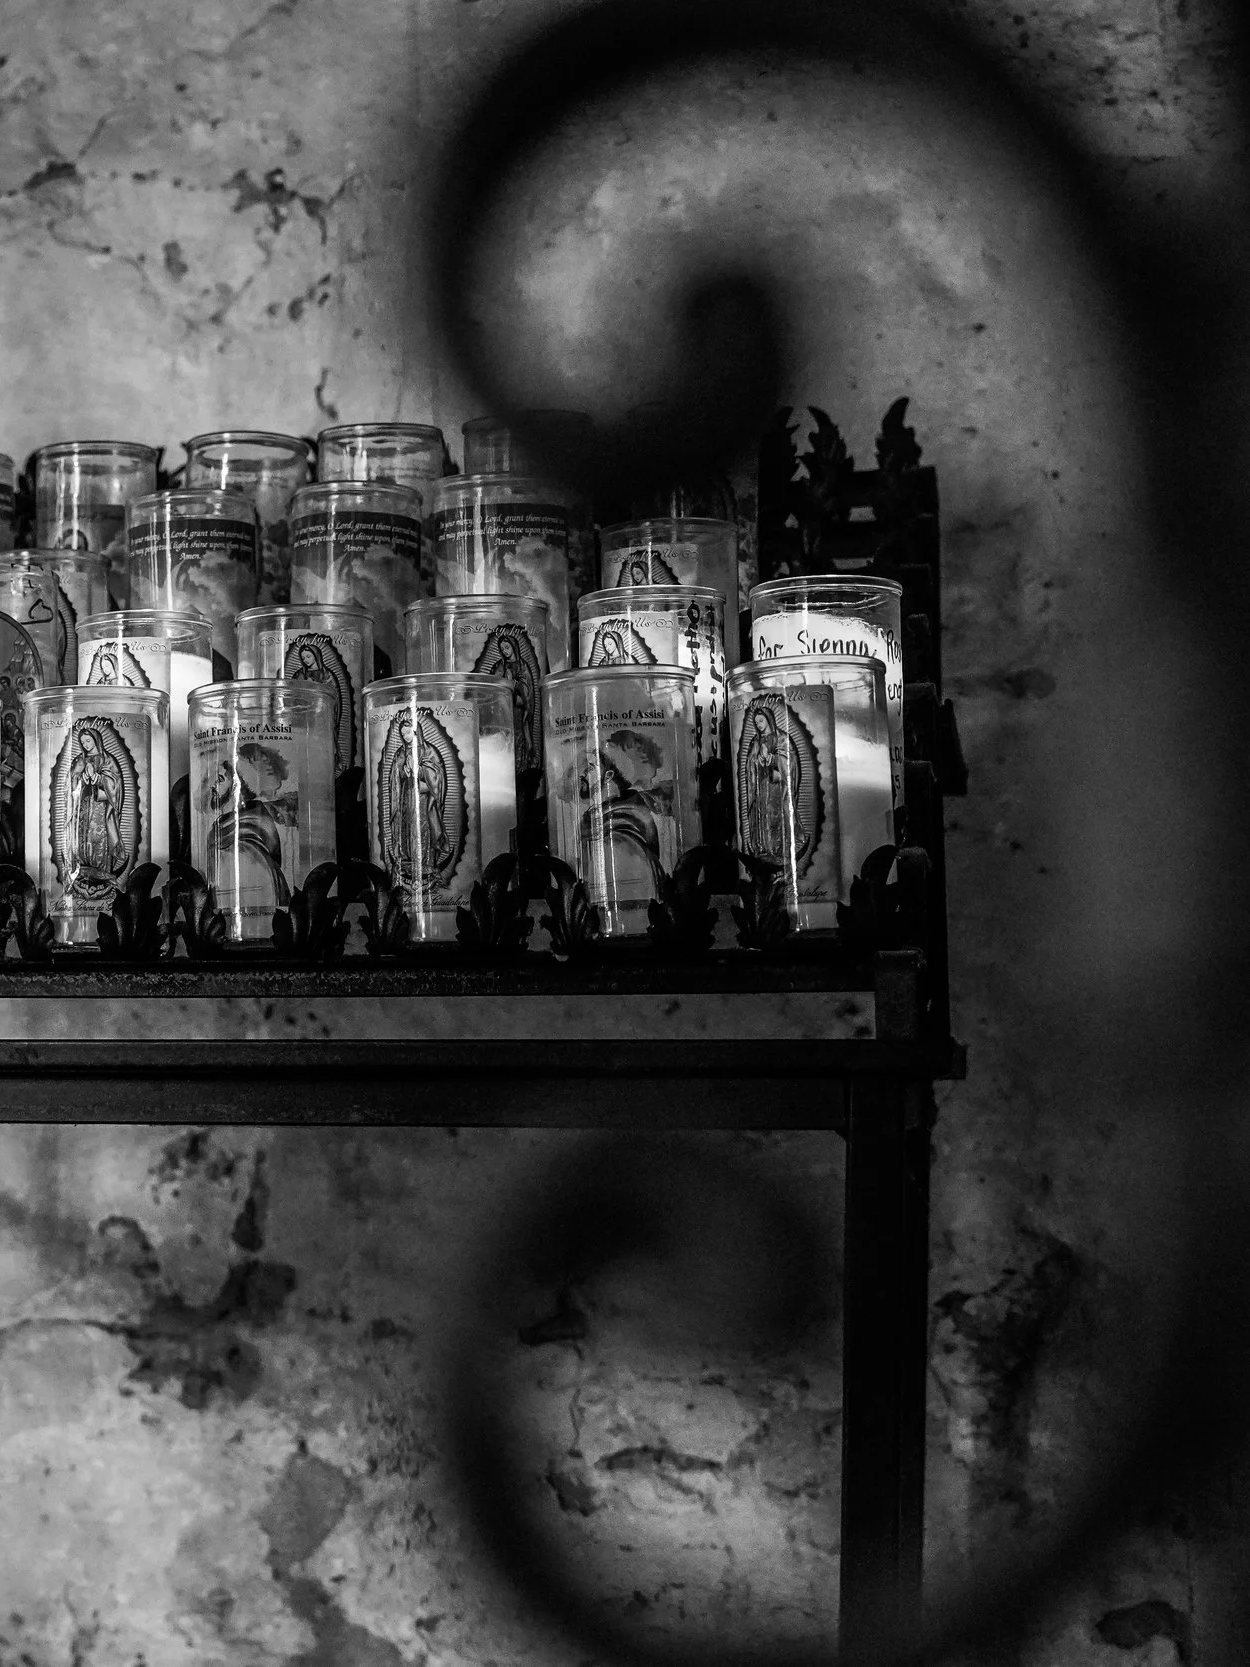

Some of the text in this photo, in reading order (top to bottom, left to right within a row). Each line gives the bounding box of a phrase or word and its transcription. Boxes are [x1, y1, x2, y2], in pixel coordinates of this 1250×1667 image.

[504, 515, 524, 525] grant
[526, 514, 541, 522] them
[336, 521, 354, 530] Lord,
[355, 522, 374, 532] grant
[375, 521, 391, 529] them
[506, 525, 524, 534] shine
[525, 528, 542, 536] upon
[170, 529, 188, 539] Lord,
[189, 530, 208, 540] grant
[210, 529, 225, 538] them
[338, 532, 354, 543] light
[354, 532, 373, 540] shine
[374, 535, 391, 544] upon
[172, 542, 189, 553] light
[190, 541, 208, 549] shine
[209, 542, 226, 550] upon
[494, 538, 516, 546] Amen.
[344, 544, 366, 552] Amen.
[180, 552, 202, 560] Amen.
[474, 623, 506, 636] Pray
[310, 634, 332, 646] for
[131, 642, 146, 651] Us
[758, 636, 784, 660] for
[762, 694, 782, 706] for
[788, 690, 806, 702] Us
[436, 706, 452, 717] Us
[90, 716, 112, 728] for
[116, 717, 129, 728] Us
[555, 716, 576, 728] Saint
[622, 710, 634, 721] of
[636, 710, 664, 720] Assisi
[194, 729, 210, 742] Saint
[250, 724, 262, 734] of
[262, 724, 292, 734] Assisi
